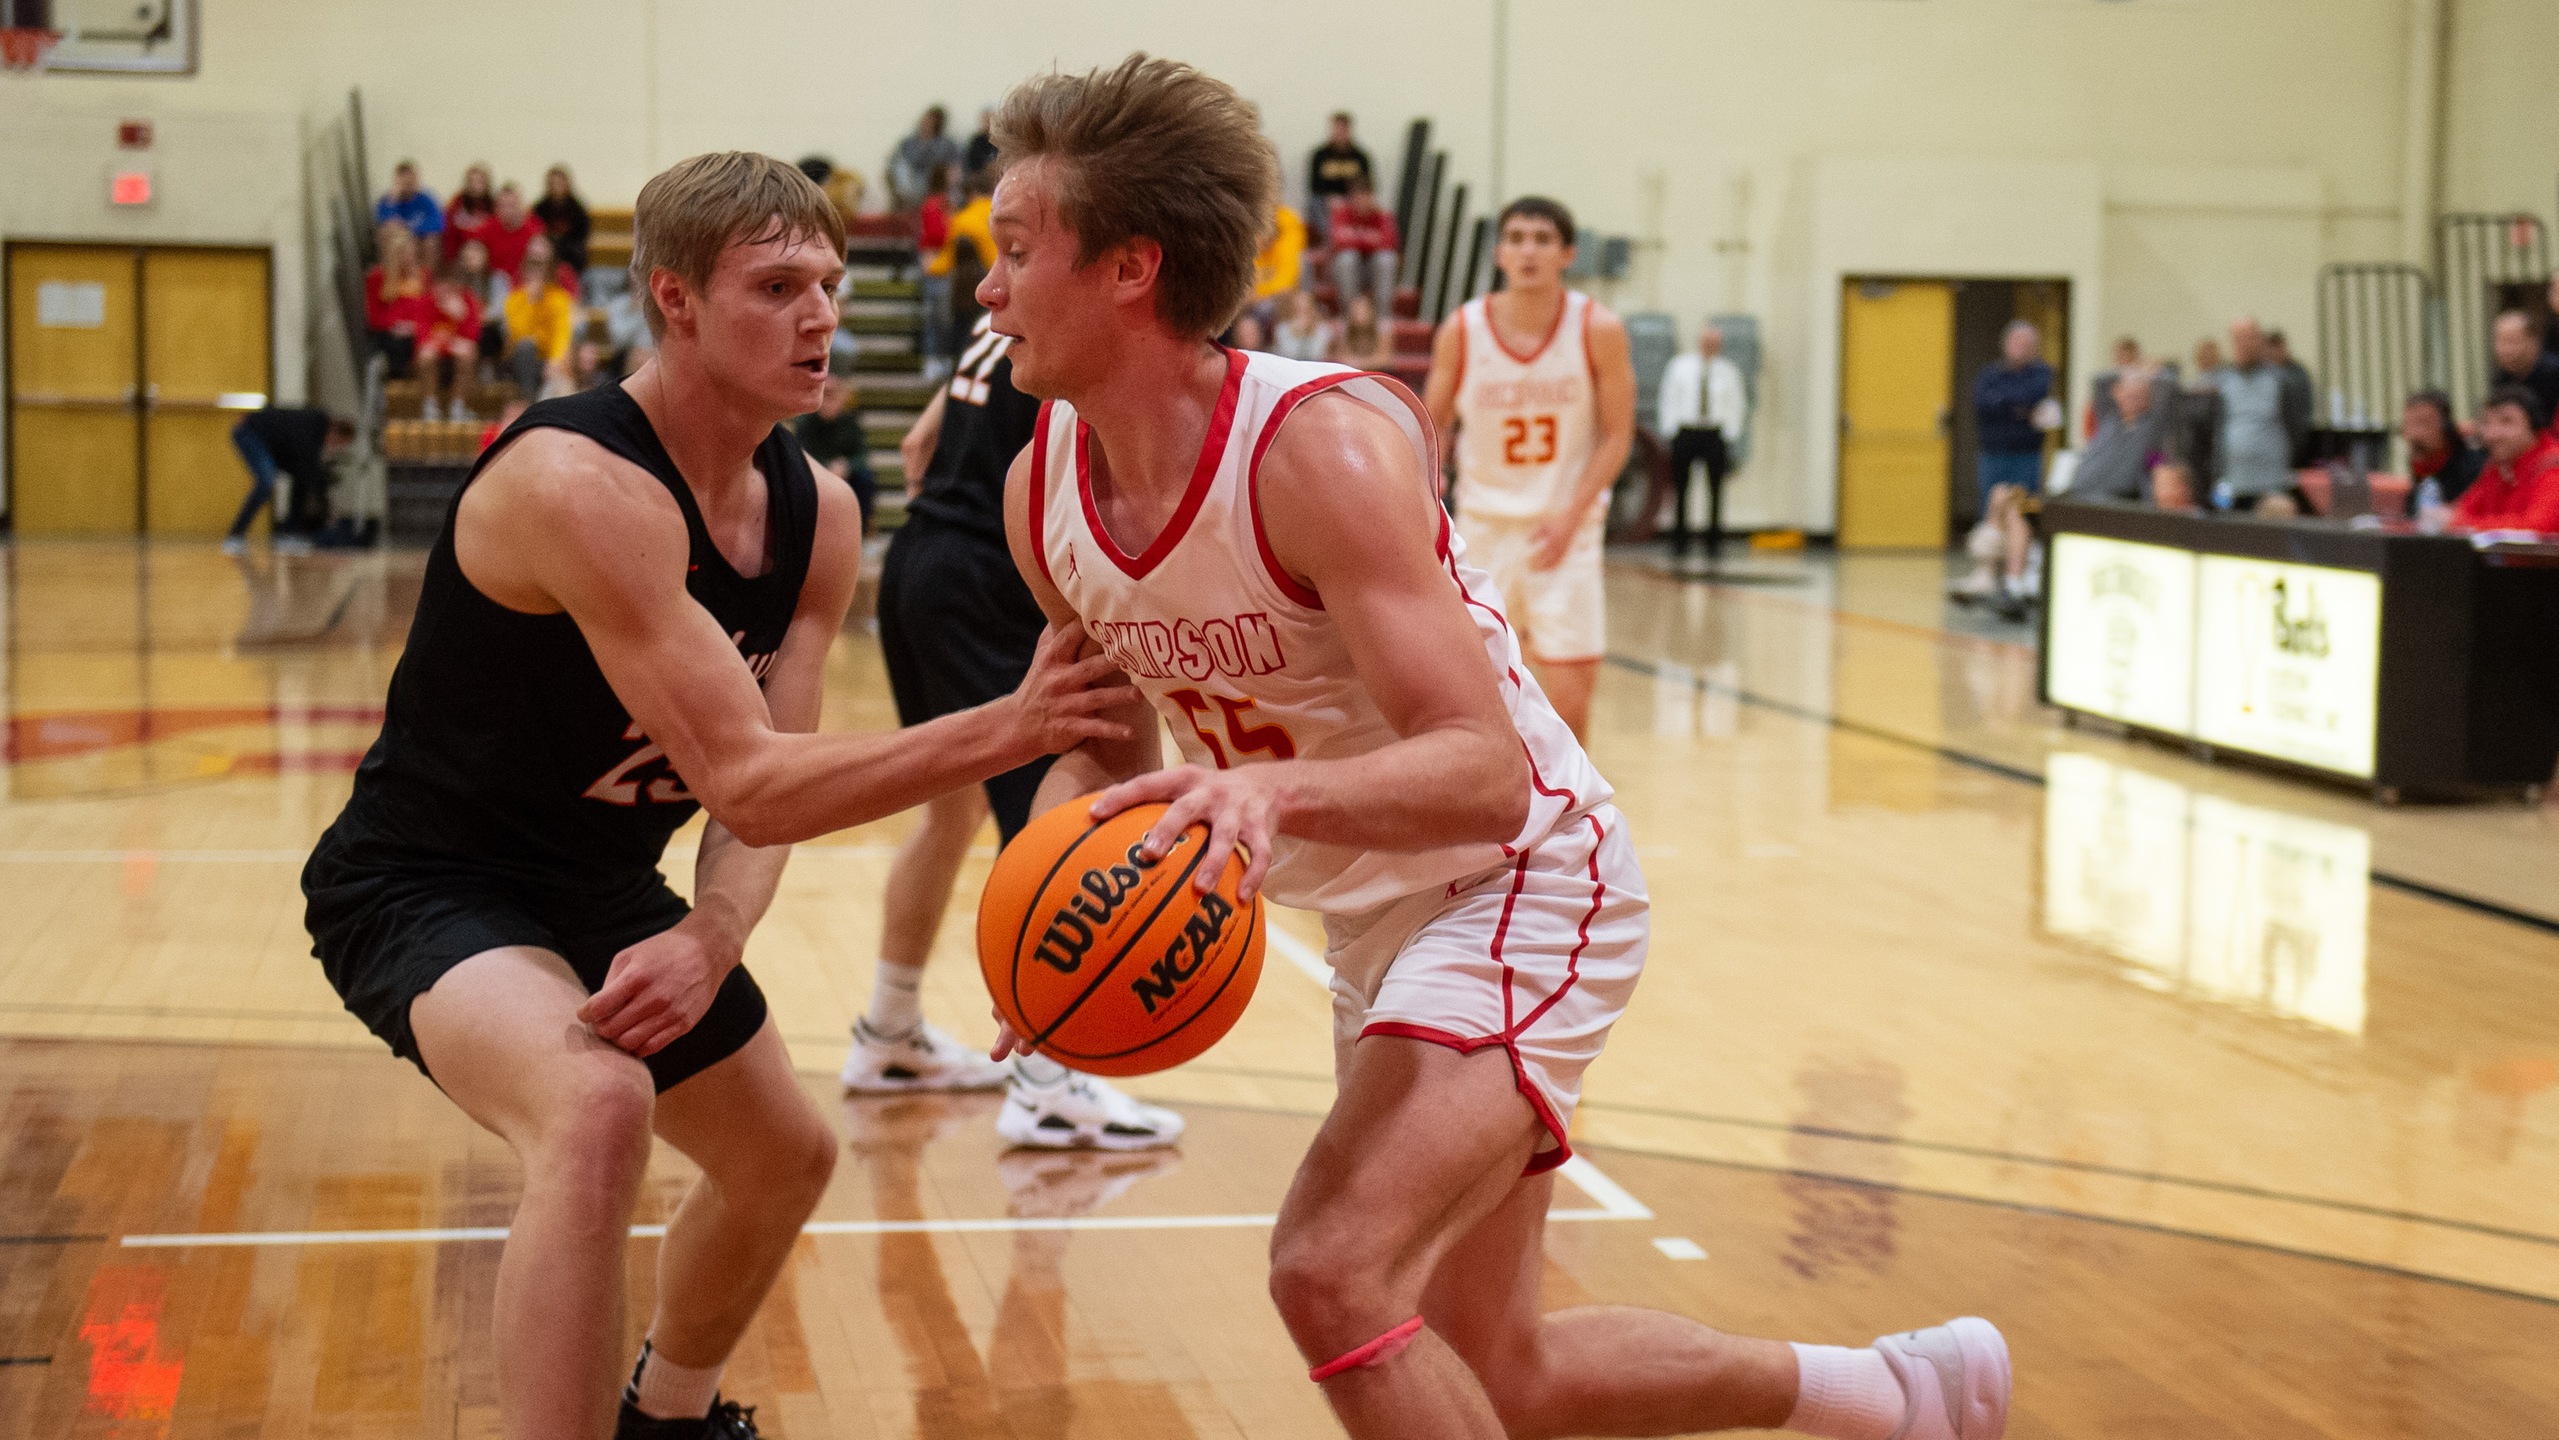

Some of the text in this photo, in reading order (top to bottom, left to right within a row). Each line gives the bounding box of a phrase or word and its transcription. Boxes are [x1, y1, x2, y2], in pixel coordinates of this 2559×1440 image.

[1504, 413, 1558, 466] 23
[1033, 830, 1191, 975] Wilso
[1130, 890, 1234, 1016] NCAA
